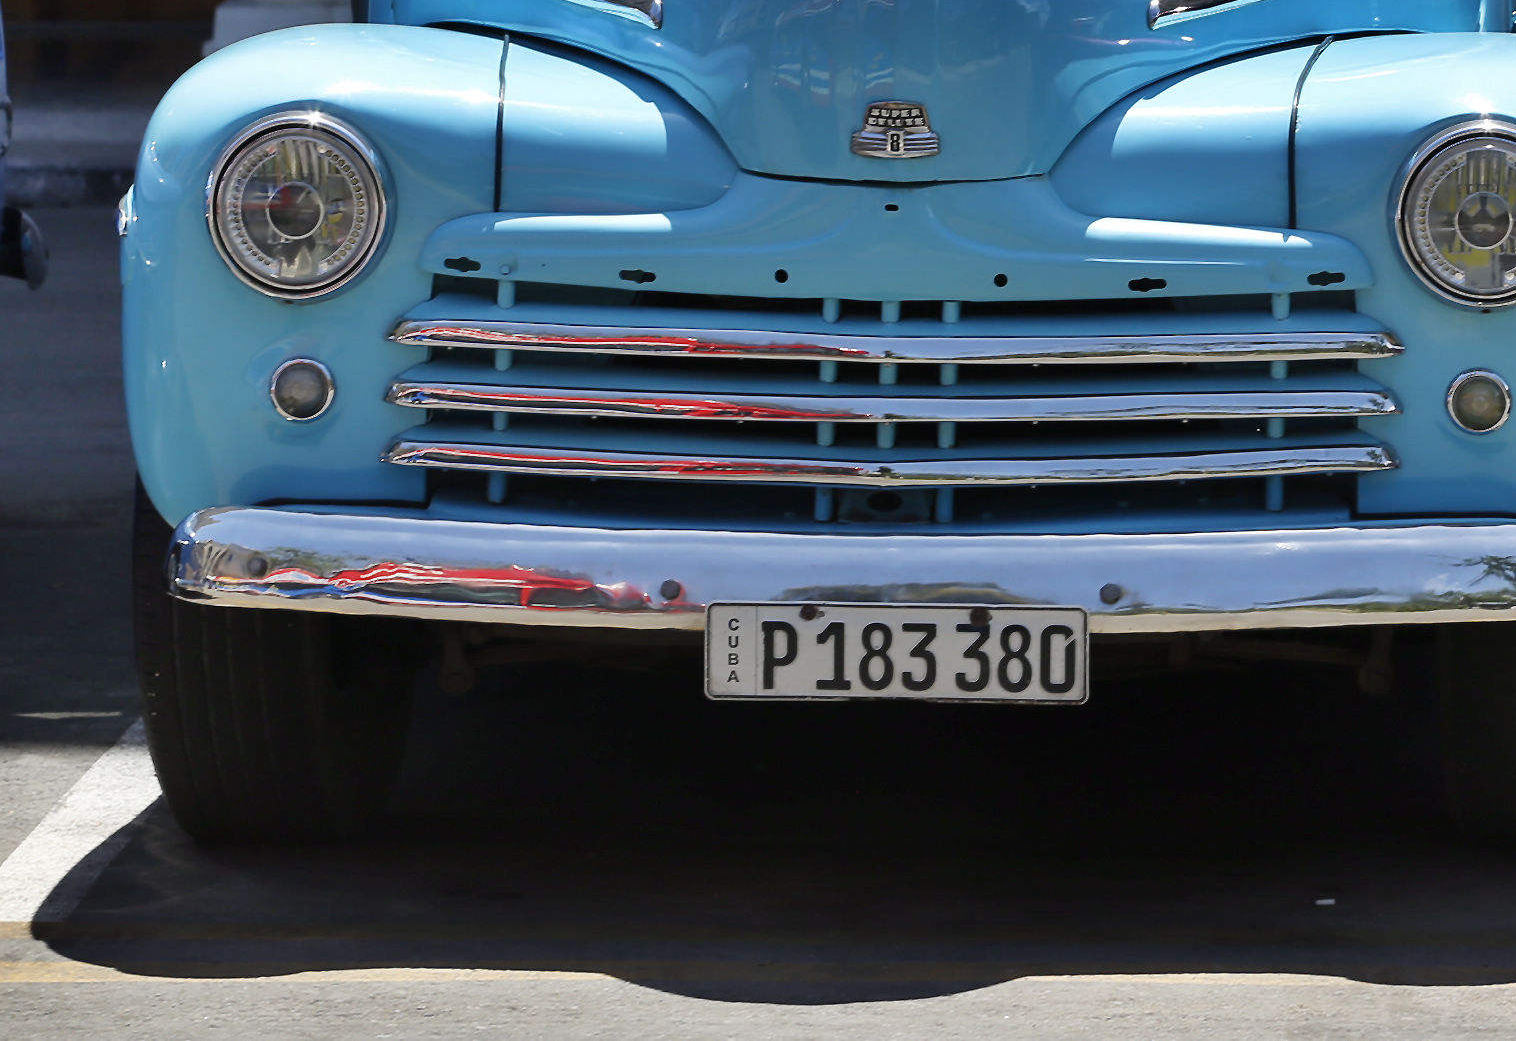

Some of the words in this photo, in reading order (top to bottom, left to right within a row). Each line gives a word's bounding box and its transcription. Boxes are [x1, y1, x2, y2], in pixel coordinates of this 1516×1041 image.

[870, 108, 921, 117] SUPER
[867, 117, 925, 127] DELUXE
[727, 618, 740, 684] CUBA
